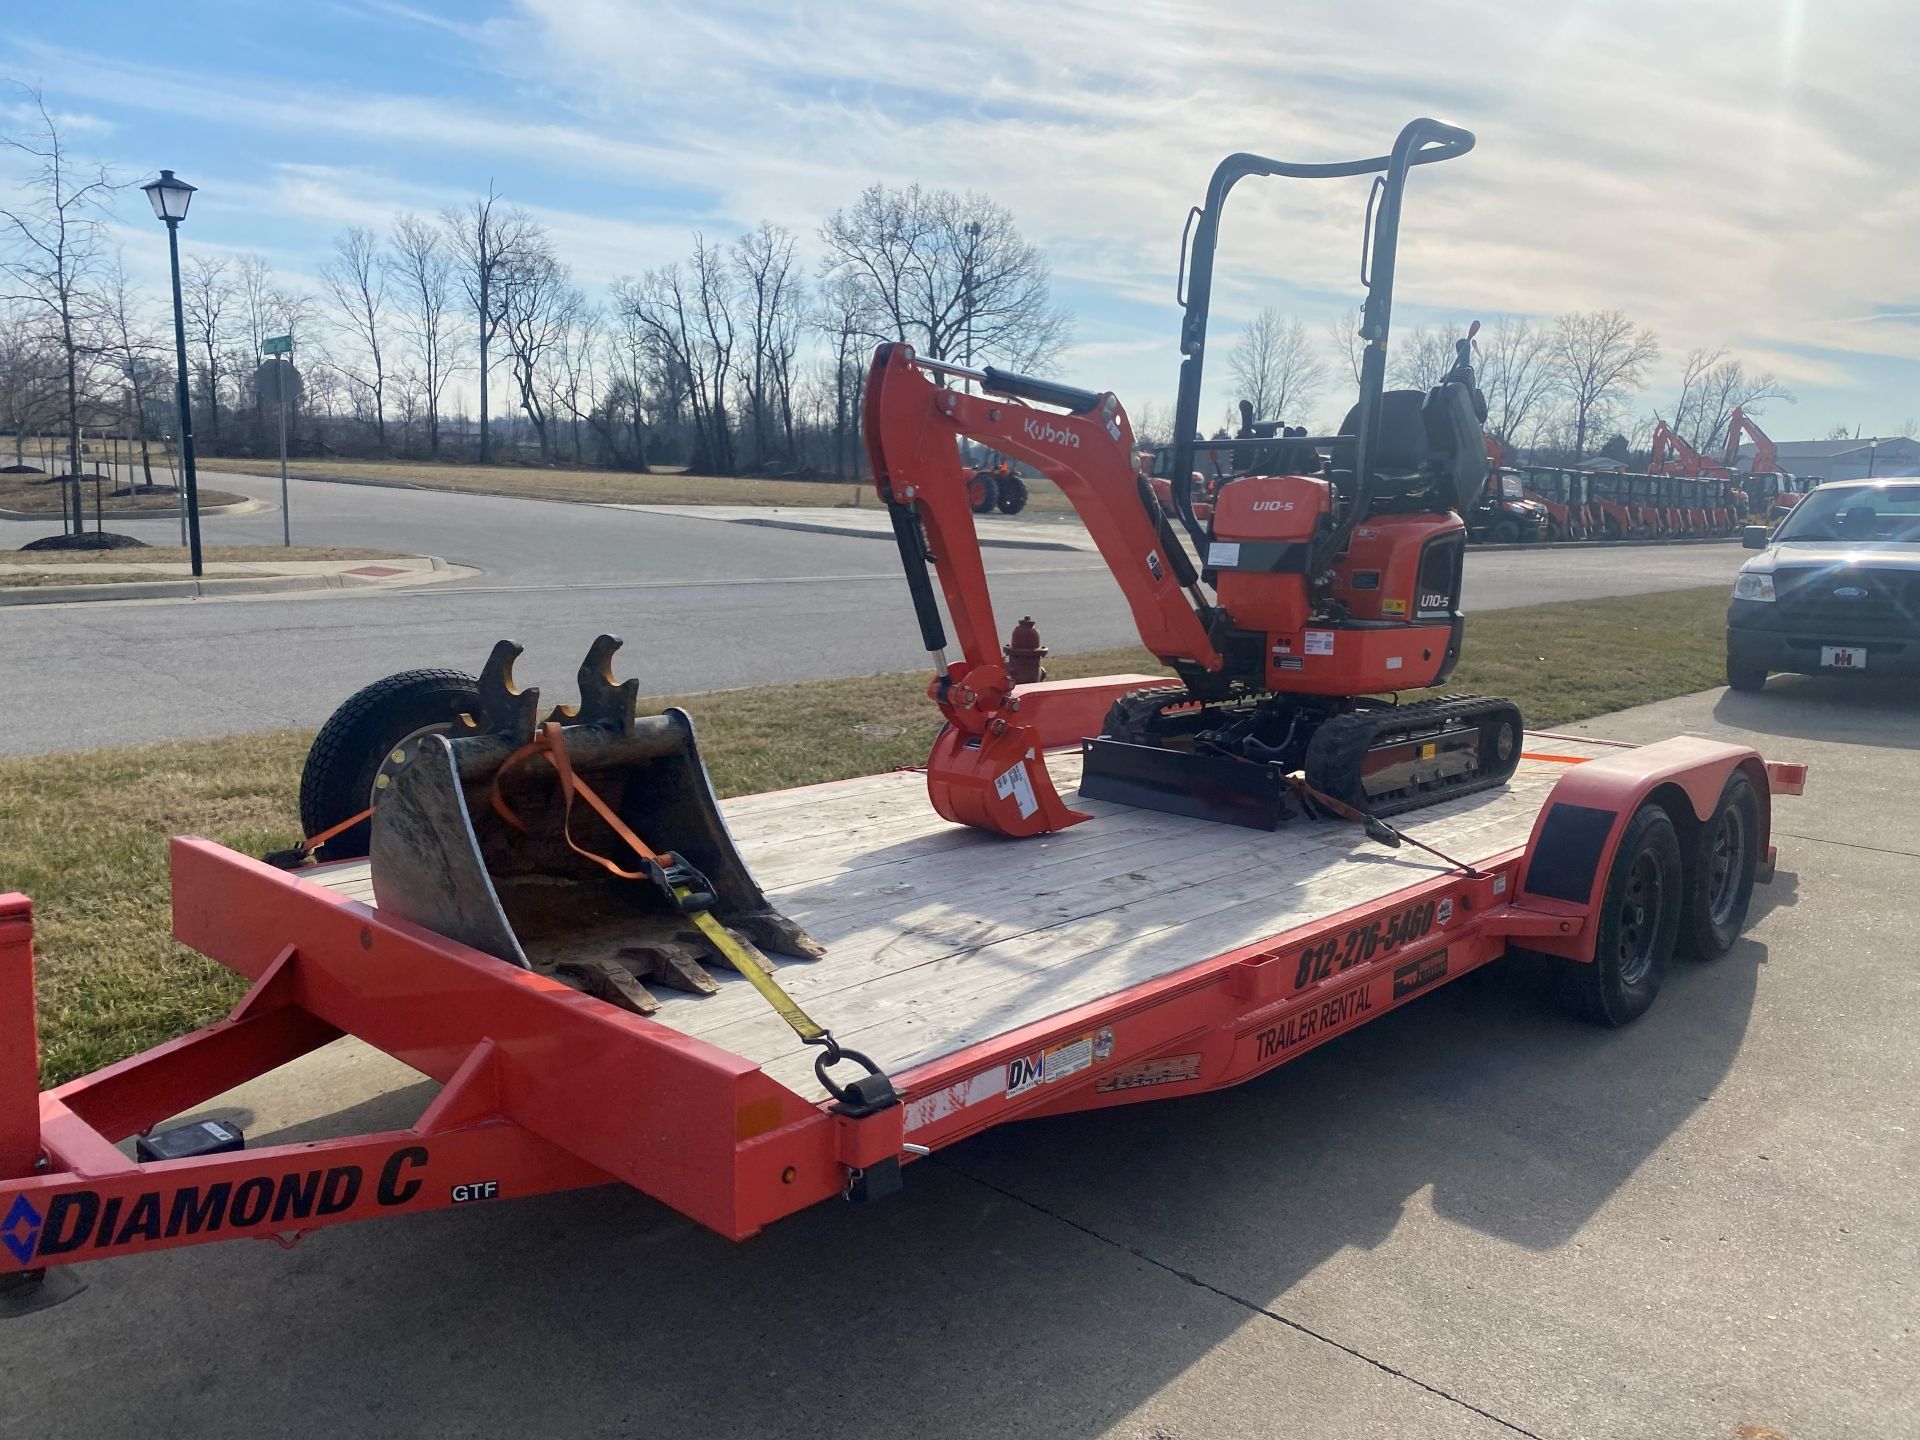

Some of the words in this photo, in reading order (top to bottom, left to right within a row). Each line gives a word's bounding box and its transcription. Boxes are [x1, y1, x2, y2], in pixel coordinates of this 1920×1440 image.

[1024, 418, 1080, 448] Kubota
[1294, 900, 1435, 989] 812-276-5460
[1256, 1009, 1318, 1062] TRAILER
[1320, 984, 1372, 1032] RENTAL
[1008, 1054, 1043, 1090] DM
[36, 1165, 363, 1256] DIAMOND
[377, 1146, 429, 1206] C
[452, 1182, 498, 1202] GTF
